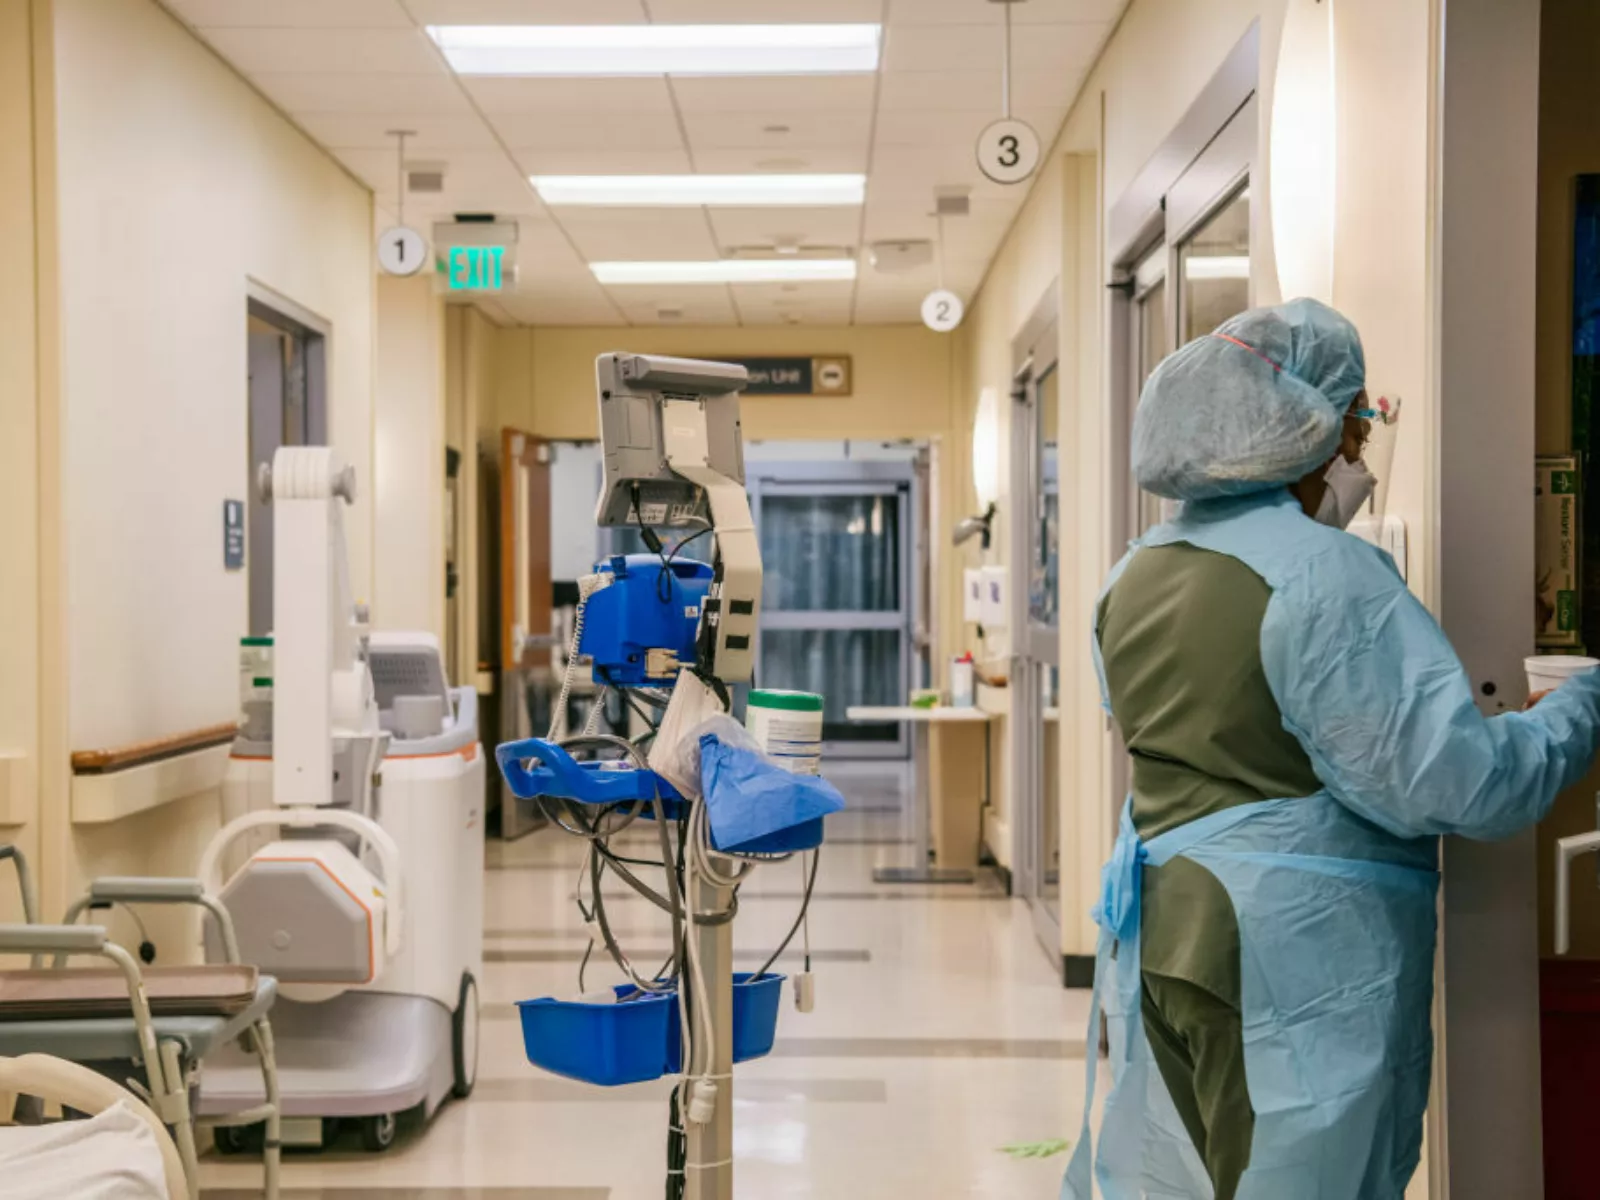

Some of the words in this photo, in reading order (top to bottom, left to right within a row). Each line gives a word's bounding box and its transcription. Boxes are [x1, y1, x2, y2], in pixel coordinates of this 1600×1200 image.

[998, 135, 1019, 167] 3
[393, 238, 404, 263] 1
[449, 246, 504, 289] EXIT
[936, 300, 950, 321] 2
